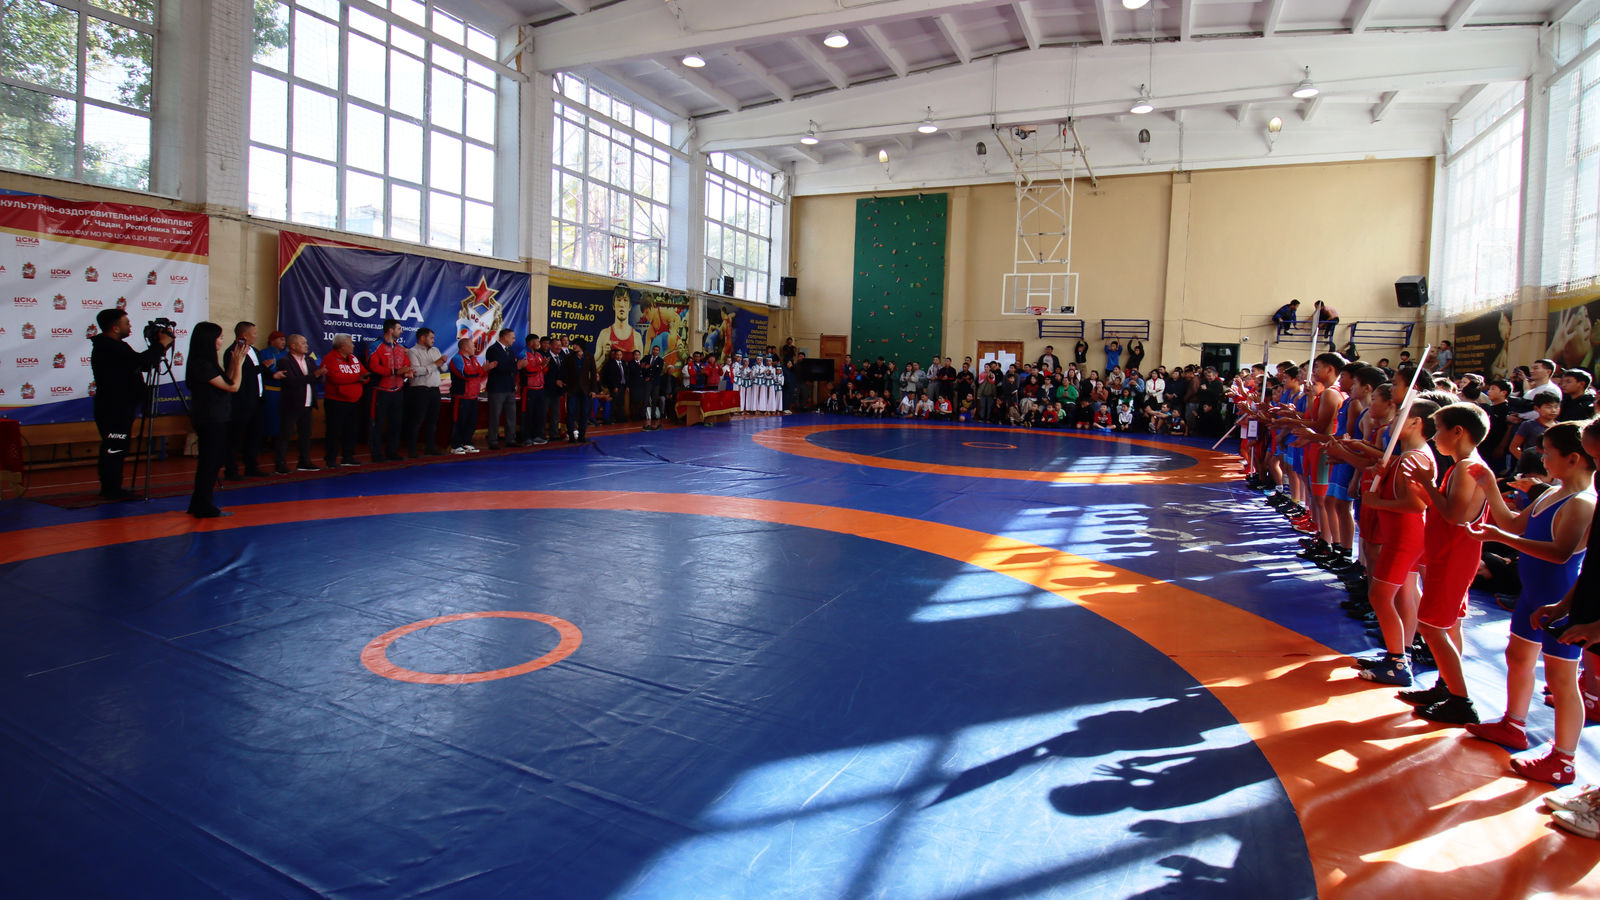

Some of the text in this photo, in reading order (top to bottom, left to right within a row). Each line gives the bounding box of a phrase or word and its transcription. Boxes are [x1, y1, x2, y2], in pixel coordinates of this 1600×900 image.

[150, 216, 193, 227] КОМПЛЕКС
[125, 222, 170, 234] Республика
[15, 236, 40, 244] ЦСКА
[14, 296, 37, 304] ЦСКА
[323, 286, 425, 322] ЦСКА
[551, 299, 583, 309] БОРЬБА
[550, 310, 595, 321] НЕ ТОЛЬКО
[353, 322, 384, 330] СОЗВЕЗД
[550, 321, 578, 330] СПОРТ
[351, 333, 362, 342] ЕТ
[550, 332, 567, 340] ЭТ
